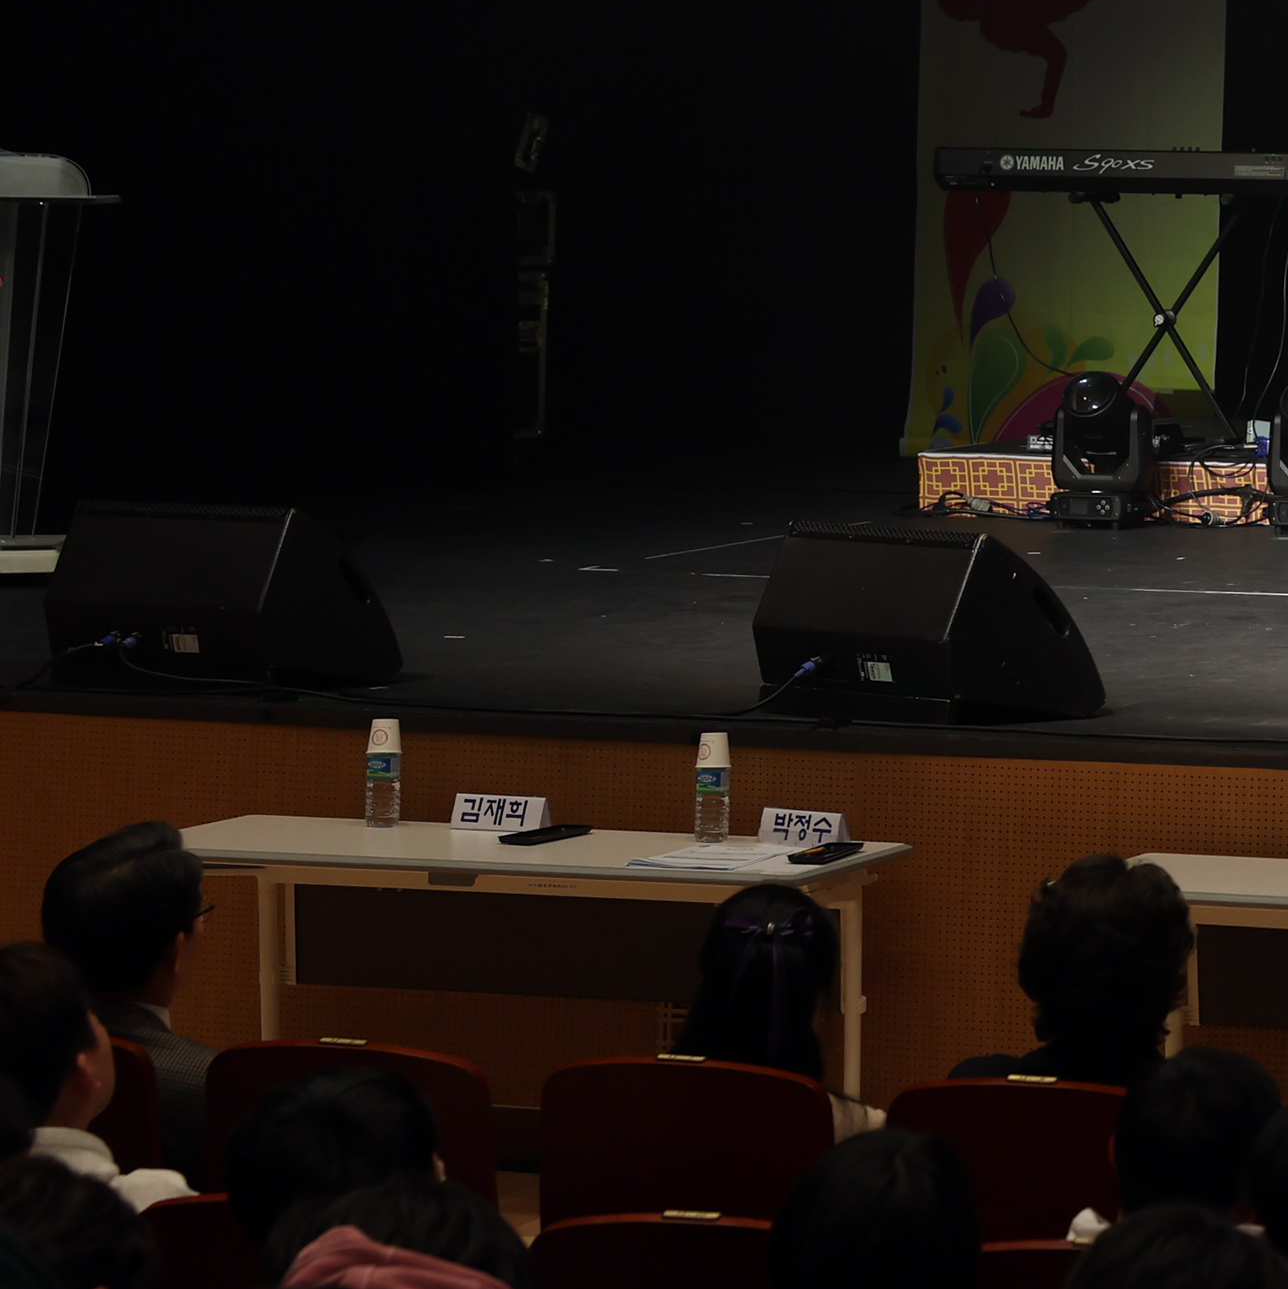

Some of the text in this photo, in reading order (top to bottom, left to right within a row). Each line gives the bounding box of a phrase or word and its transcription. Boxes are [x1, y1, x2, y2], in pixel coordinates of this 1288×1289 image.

[1015, 155, 1065, 171] YAMAHA
[460, 797, 528, 827] 김재희
[772, 812, 832, 843] 박정수
